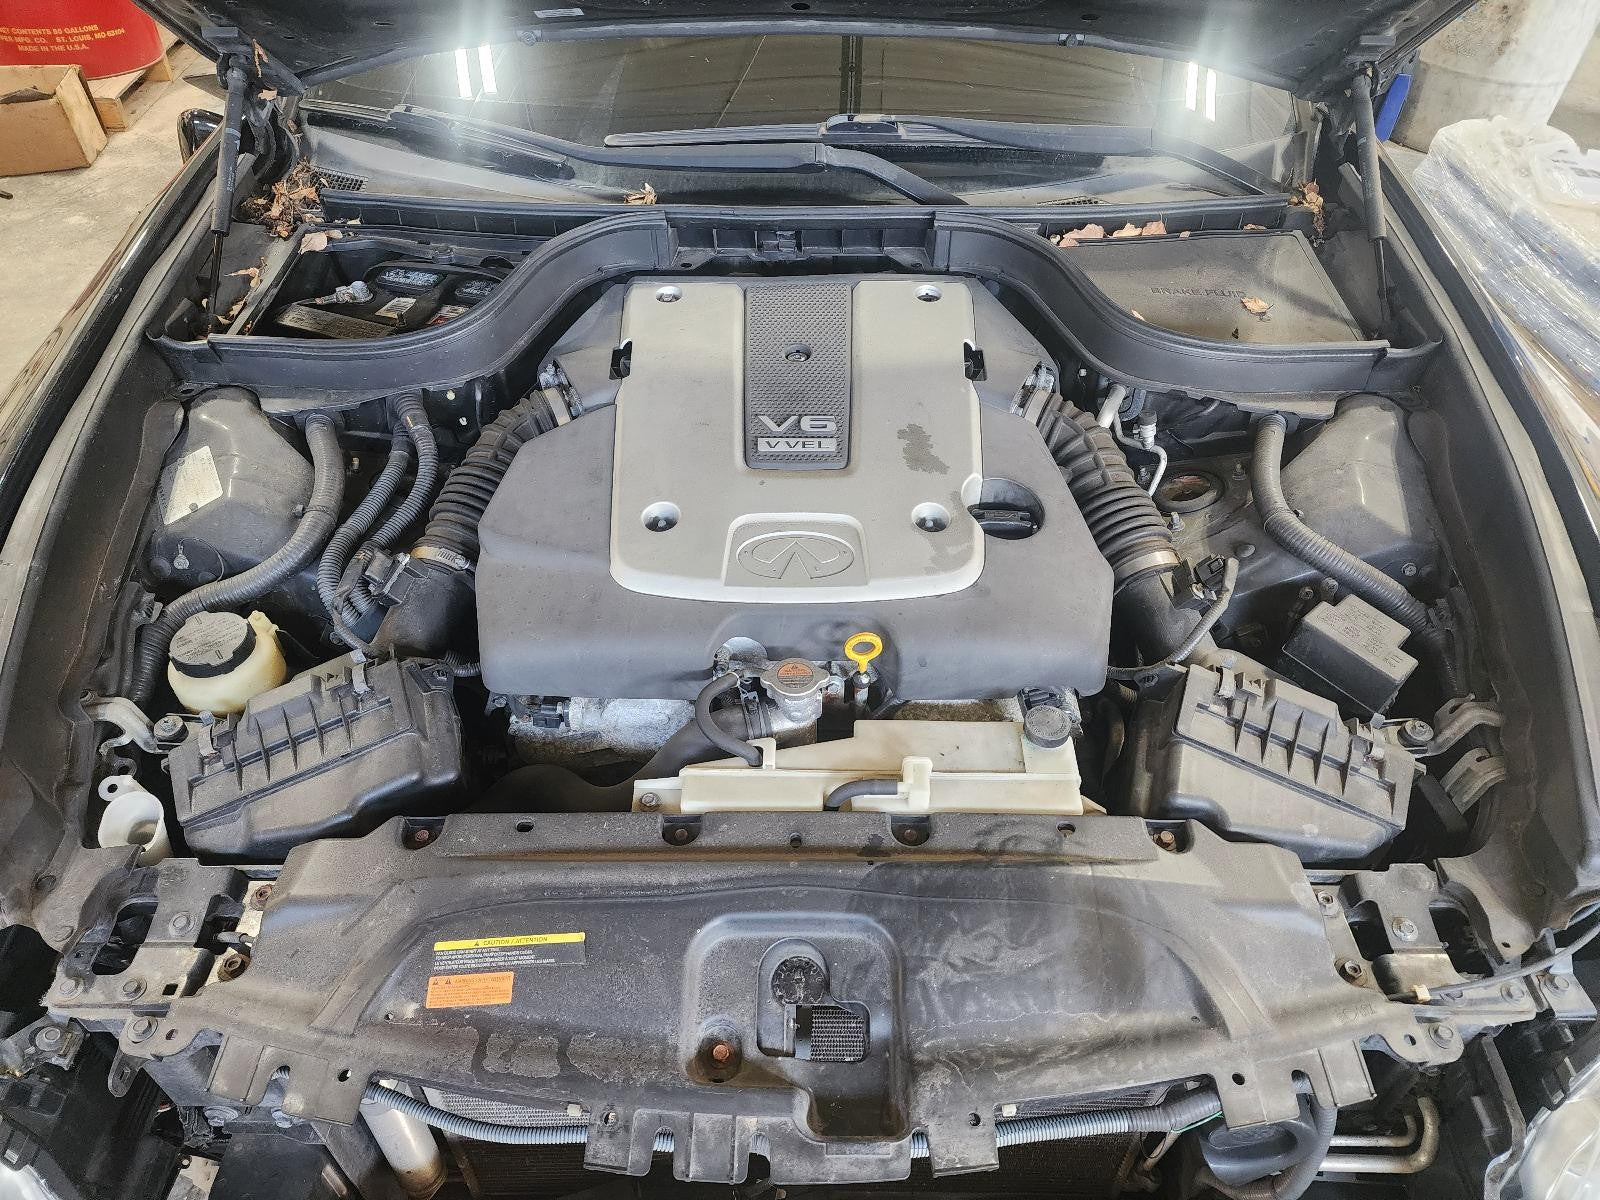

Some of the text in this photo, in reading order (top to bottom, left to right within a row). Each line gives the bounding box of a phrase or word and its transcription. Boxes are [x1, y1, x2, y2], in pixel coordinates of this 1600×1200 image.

[11, 27, 52, 35] CONTENTS
[64, 24, 99, 34] GALLONS
[69, 34, 94, 42] LOUIS,
[18, 44, 40, 52] MADE
[51, 44, 65, 52] THE
[66, 43, 89, 51] U.S.A.
[1150, 287, 1203, 296] BRAKE
[758, 415, 838, 432] V6
[765, 440, 830, 449] VVEL
[483, 938, 510, 946] CAUTION
[516, 936, 548, 944] ATTENTION
